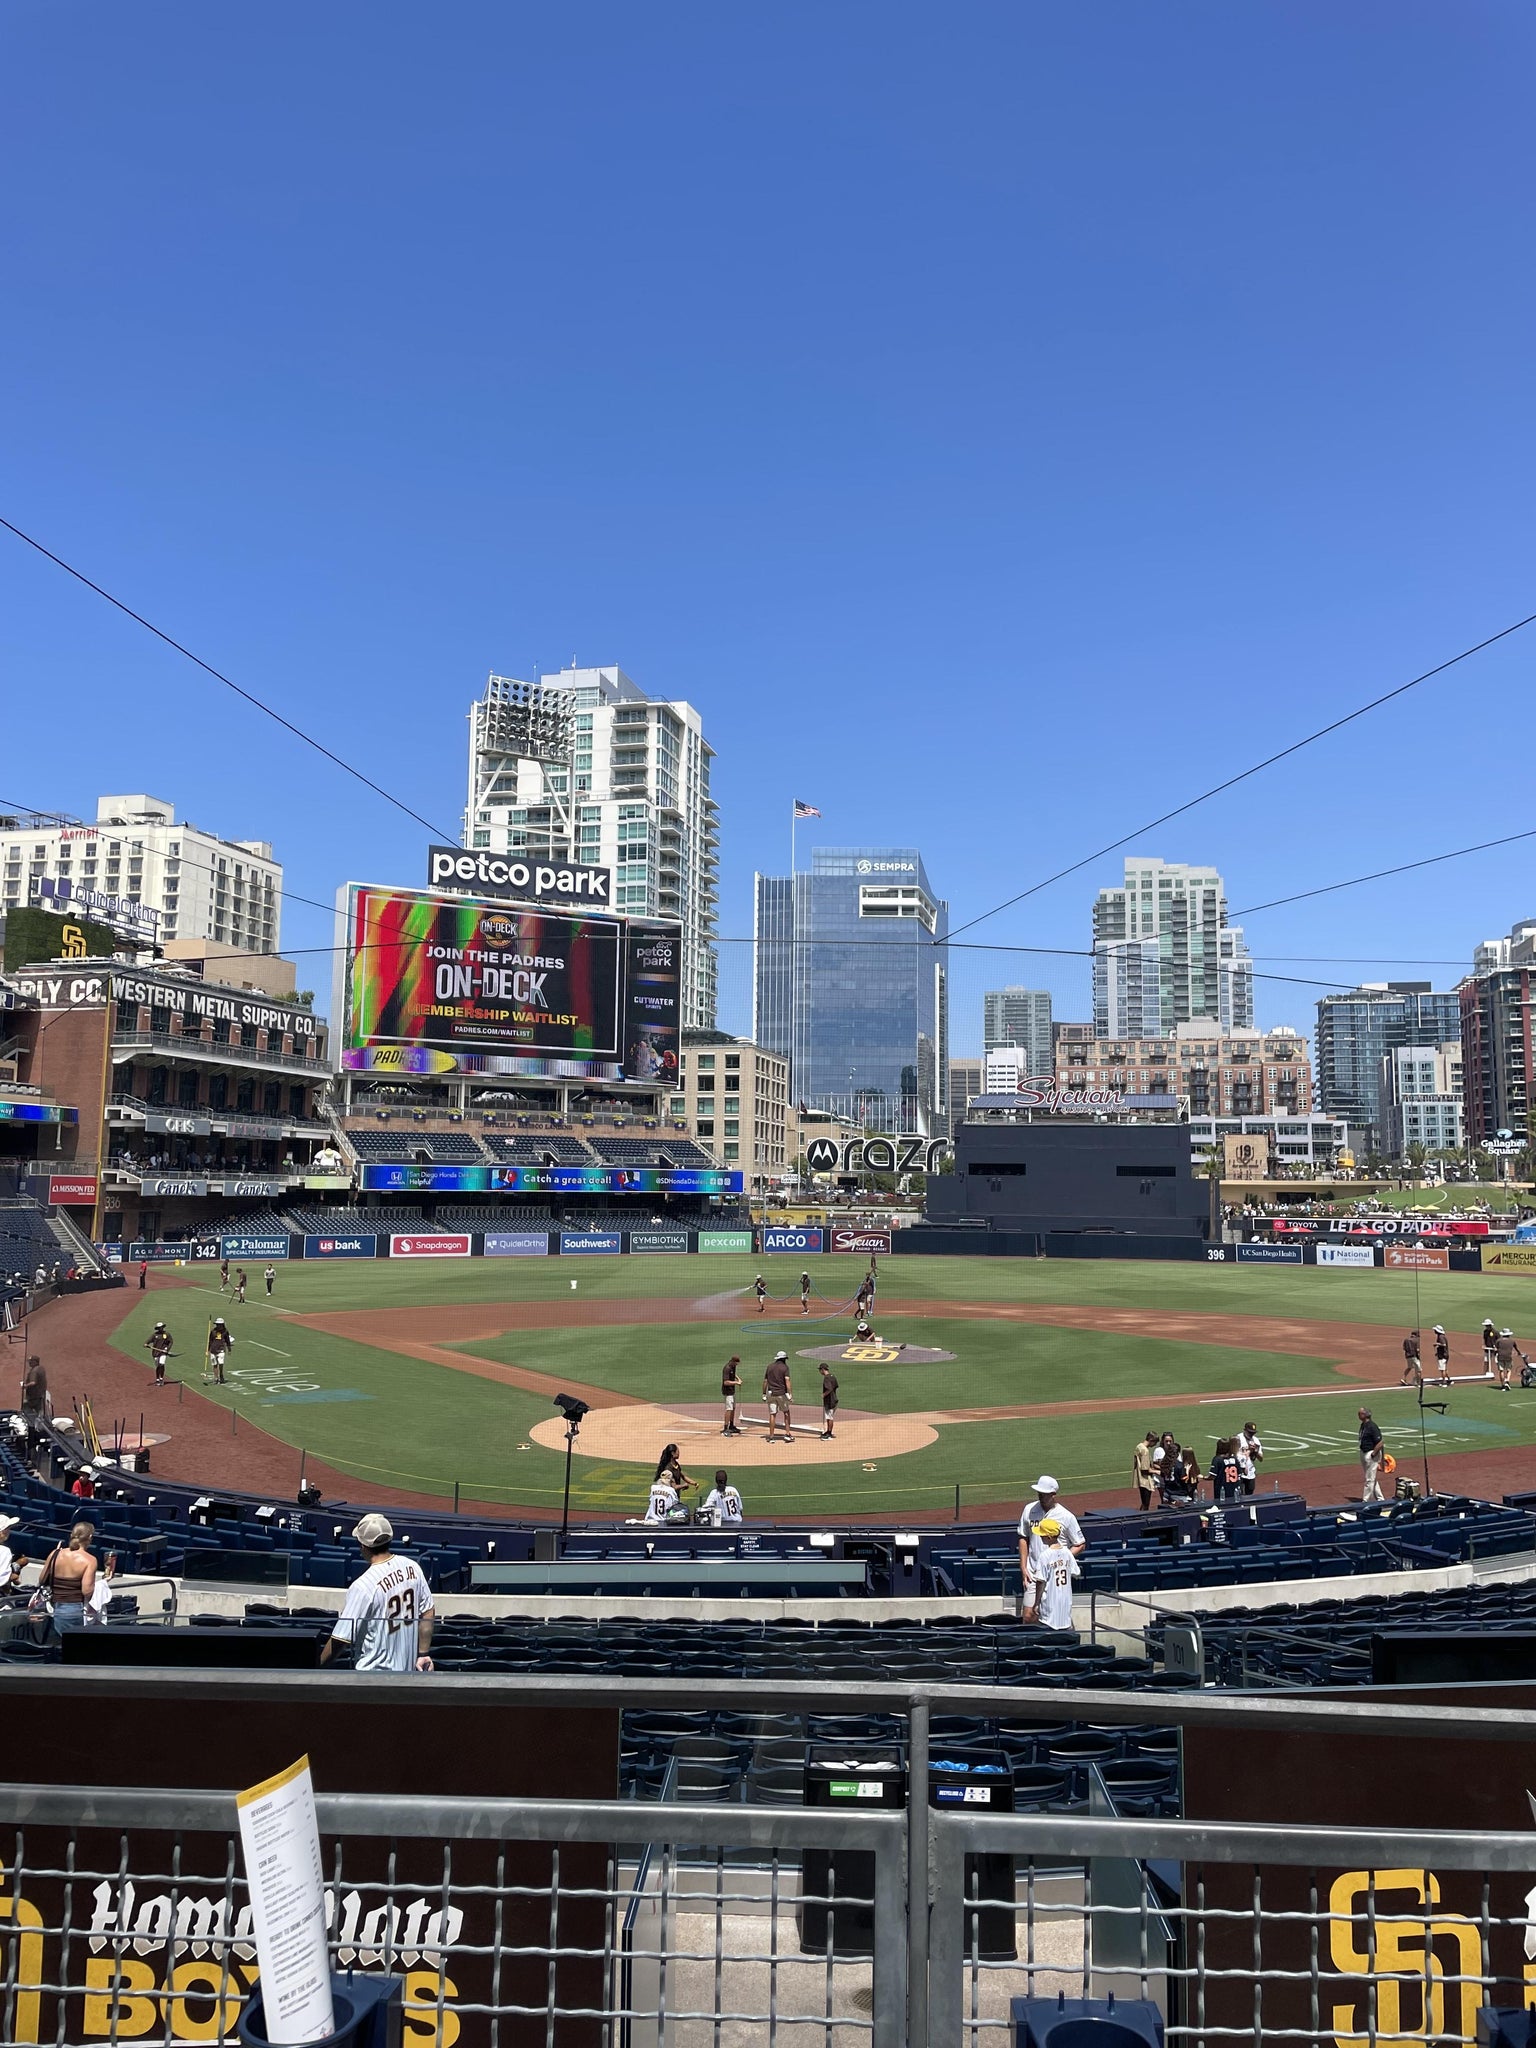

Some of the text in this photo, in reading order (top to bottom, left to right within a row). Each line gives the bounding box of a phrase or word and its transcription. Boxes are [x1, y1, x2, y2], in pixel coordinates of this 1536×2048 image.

[59, 828, 99, 841] Marriott
[873, 862, 915, 871] SEMPRA
[432, 853, 608, 897] petco park
[76, 885, 158, 924] QuidelOrtho
[481, 920, 518, 936] ON-DECK
[426, 945, 565, 970] JOIN THE PADRES
[636, 946, 672, 958] petco
[642, 957, 672, 968] park
[70, 979, 107, 1003] CO.
[435, 963, 549, 1009] ON-DECK
[111, 977, 315, 1036] WESTERN METAL SUPPLY CO.
[634, 996, 674, 1006] CUTWATER
[512, 1011, 578, 1026] WAITLIST
[454, 1026, 531, 1038] PADRES.COM/WAITLIST
[1014, 1075, 1125, 1114] Sycuan
[1480, 1139, 1529, 1149] Gallagher
[842, 1137, 949, 1171] razr
[1487, 1147, 1520, 1156] Square
[523, 1174, 551, 1183] Catch
[561, 1176, 586, 1186] great
[588, 1176, 612, 1184] deal!
[1288, 1221, 1319, 1229] TOYOTA
[1372, 1221, 1397, 1233] GO
[240, 1239, 285, 1249] Palomar
[320, 1239, 361, 1250] us bank
[415, 1240, 462, 1250] Snapdragon
[499, 1239, 546, 1248] QuidelOrtho
[564, 1238, 611, 1249] Southwest
[632, 1236, 686, 1244] CYMBIOTIKA
[766, 1235, 806, 1247] ARCO
[835, 1231, 885, 1251] Sycuan
[196, 1245, 216, 1258] 342
[1207, 1249, 1225, 1260] 396
[1262, 1250, 1278, 1258] Diego
[1337, 1250, 1370, 1258] National
[1224, 1465, 1238, 1483] 19
[655, 1498, 665, 1515] 13
[725, 1498, 737, 1516] 13
[377, 1565, 418, 1593] TATIS JR.
[387, 1588, 415, 1635] 23
